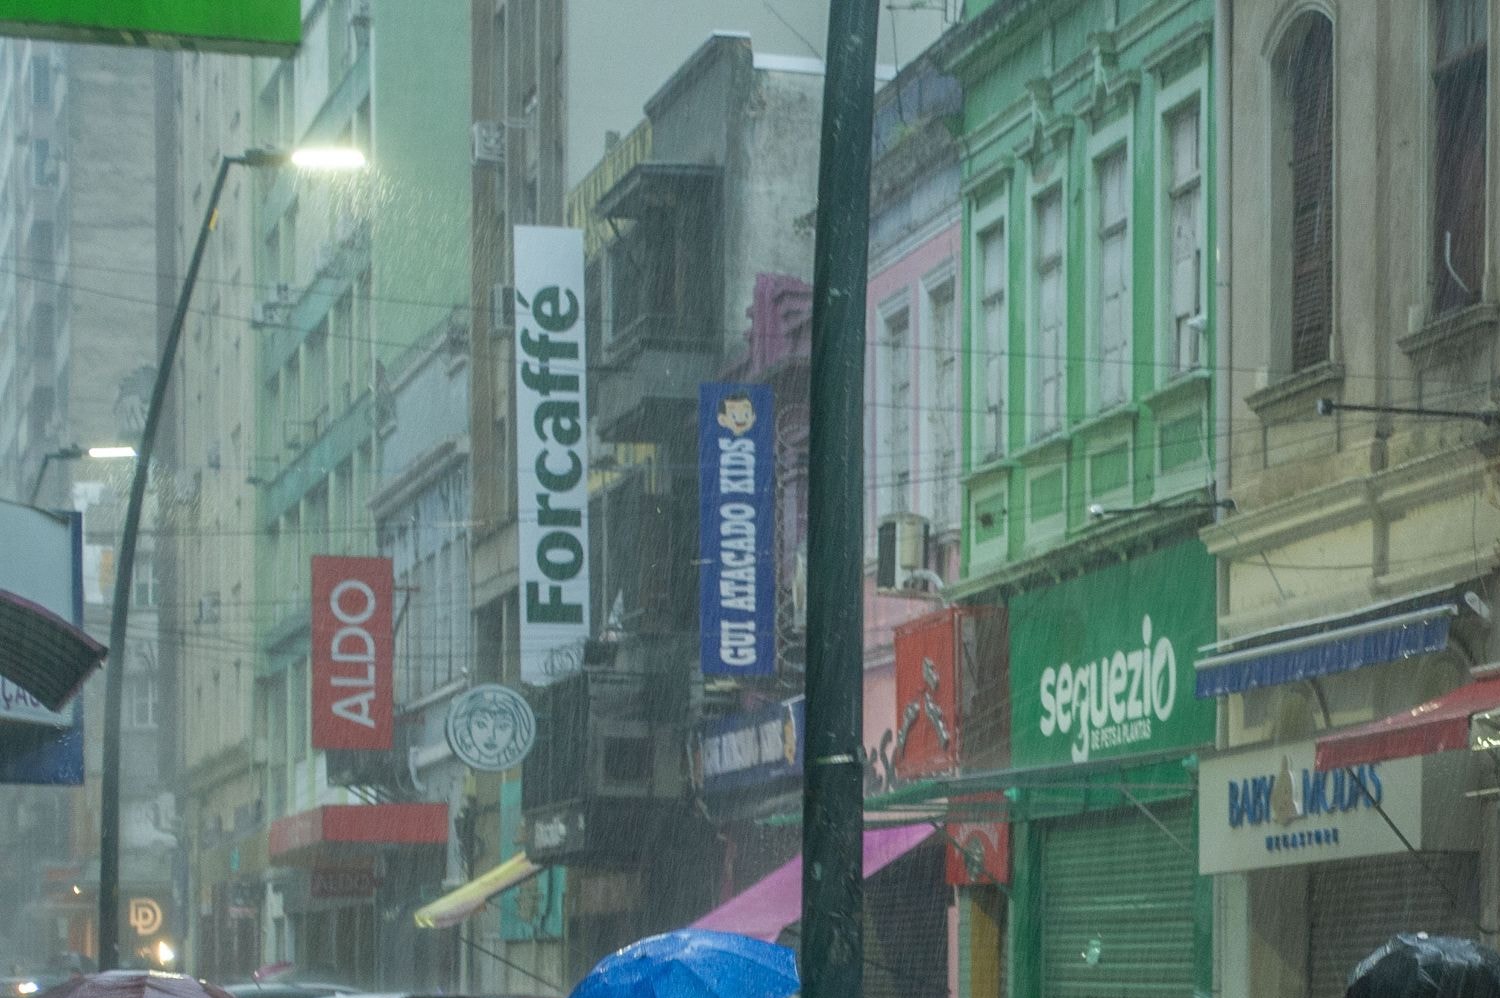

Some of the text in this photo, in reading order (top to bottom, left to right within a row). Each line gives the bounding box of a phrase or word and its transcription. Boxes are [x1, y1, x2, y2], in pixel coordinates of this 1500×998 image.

[516, 285, 584, 624] Forcaffé
[718, 436, 757, 666] GUI ATACADO KIDS
[330, 579, 376, 729] ALDO
[1229, 774, 1275, 829] BABY
